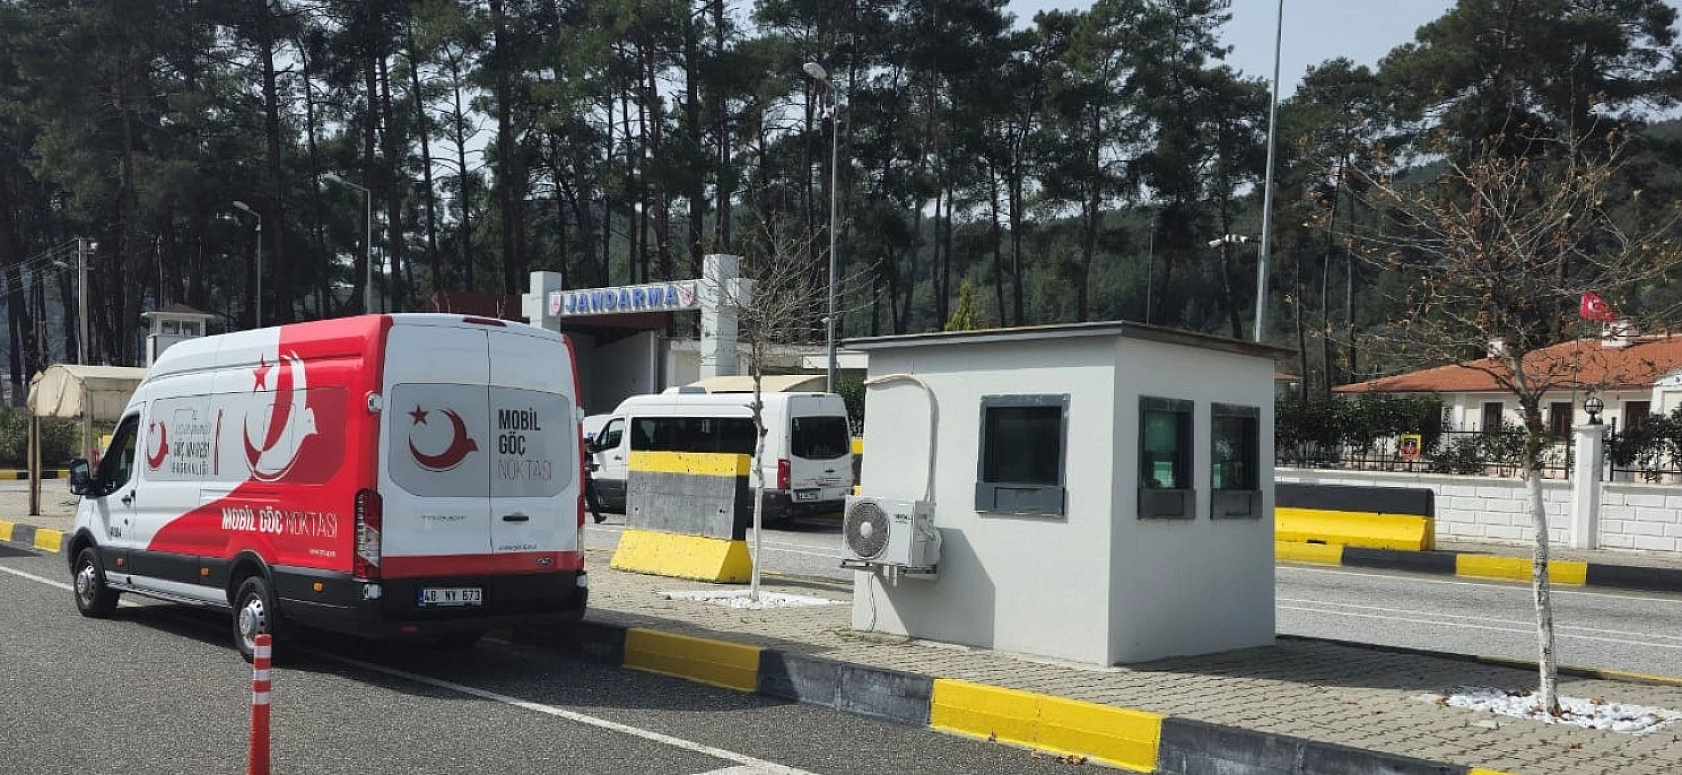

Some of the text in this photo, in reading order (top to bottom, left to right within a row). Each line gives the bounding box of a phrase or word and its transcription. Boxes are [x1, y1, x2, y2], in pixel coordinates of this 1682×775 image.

[565, 283, 679, 312] JANDARMA
[498, 406, 541, 431] MOBİL
[498, 431, 526, 457] GÖÇ
[497, 459, 552, 480] NOKTASI
[221, 504, 338, 538] MOBİL GÖÇ NOKTASI
[445, 590, 456, 601] NY
[462, 590, 481, 601] 673
